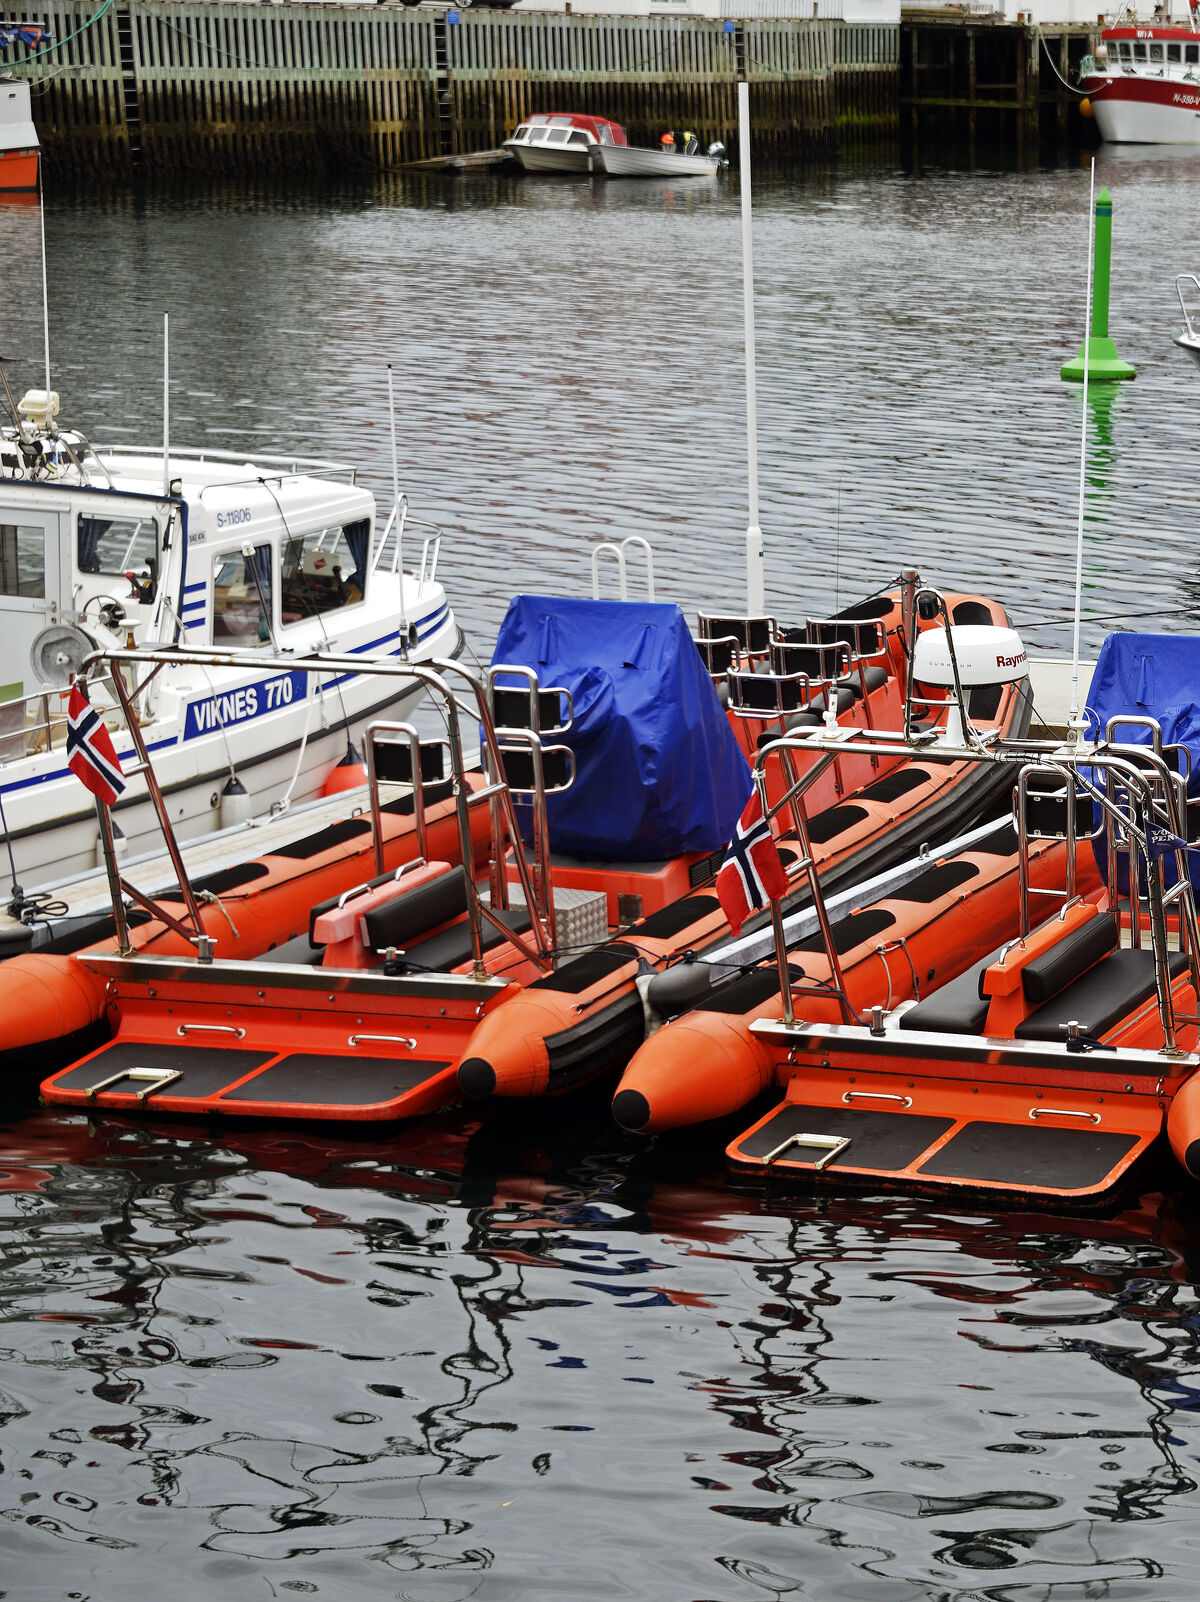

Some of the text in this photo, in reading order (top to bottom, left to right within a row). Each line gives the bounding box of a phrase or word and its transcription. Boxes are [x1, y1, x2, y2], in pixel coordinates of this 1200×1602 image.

[1136, 29, 1153, 39] MIA
[216, 507, 252, 528] S-11806
[193, 676, 293, 732] VIKNES 770
